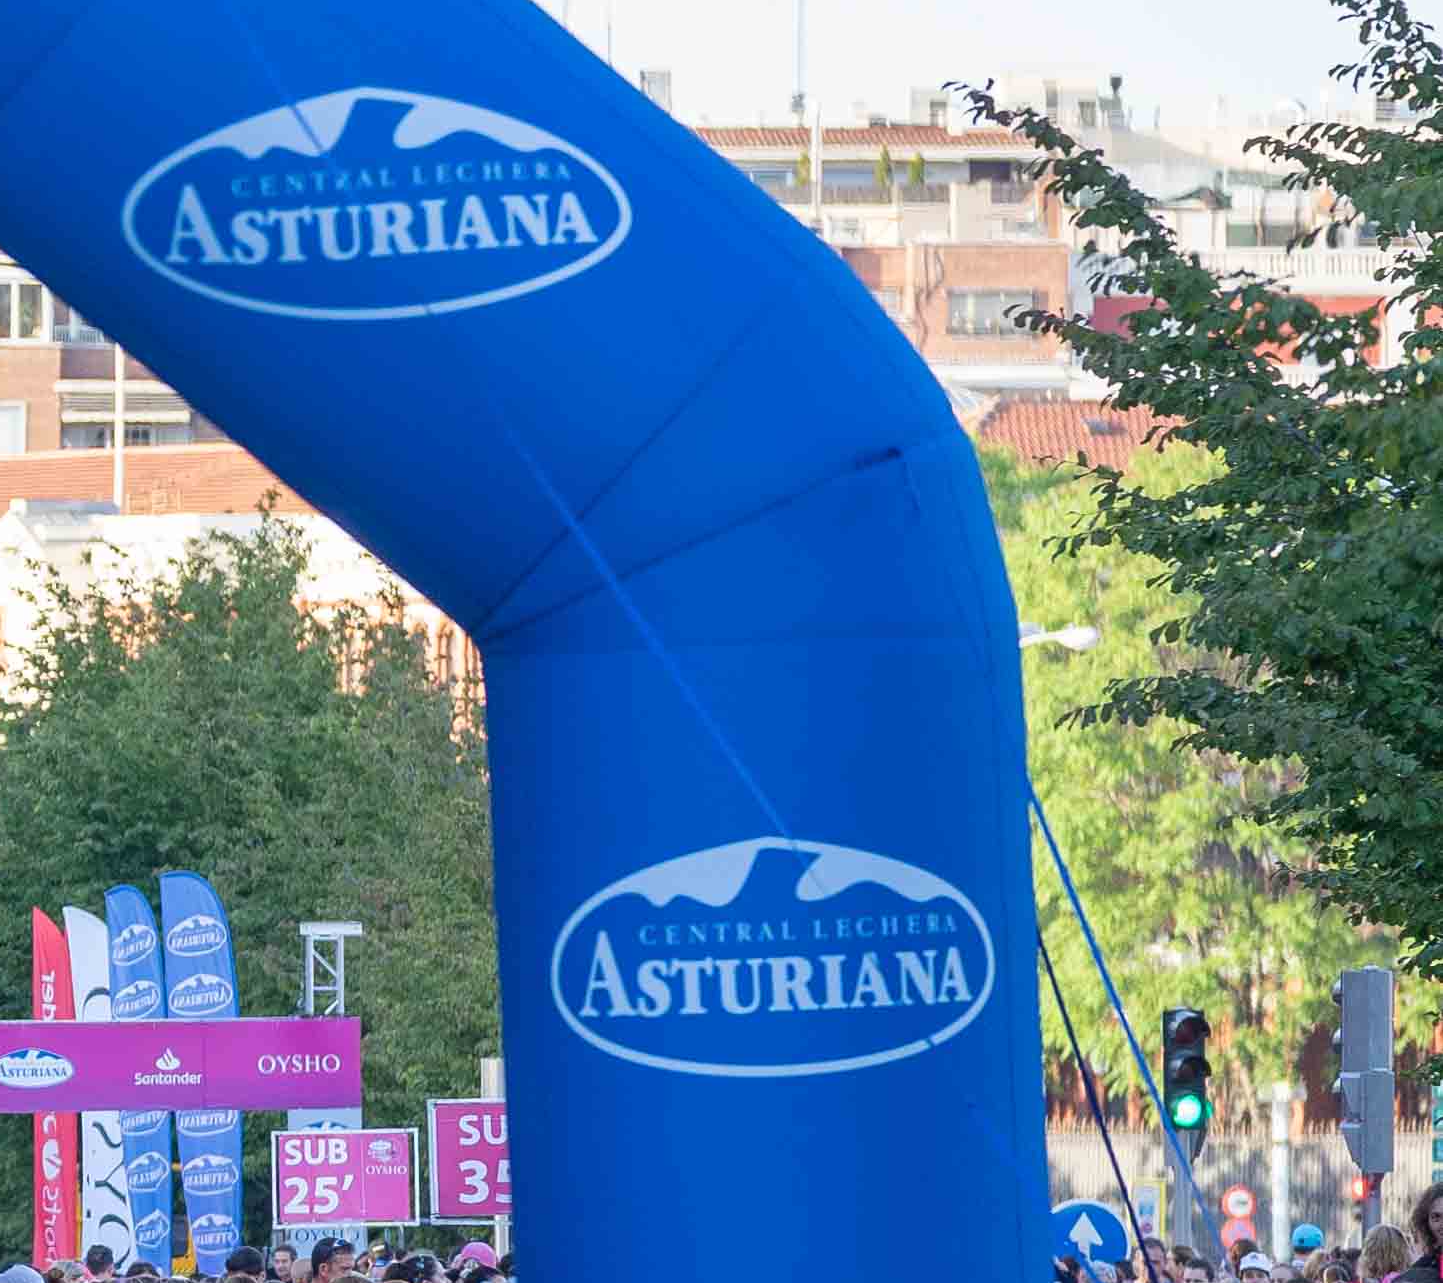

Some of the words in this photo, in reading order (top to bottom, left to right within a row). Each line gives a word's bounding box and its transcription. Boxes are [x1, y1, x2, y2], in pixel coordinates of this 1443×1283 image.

[231, 169, 396, 198] CENTRAL
[412, 161, 572, 187] LECHERA
[165, 183, 599, 266] ASTURIANA
[638, 919, 798, 947] CENTRAL
[812, 911, 961, 941] LECHERA
[578, 930, 973, 1018] ASTURIANA
[133, 1072, 203, 1086] Santander
[257, 1053, 341, 1075] OYSHO
[458, 1114, 509, 1147] SU
[284, 1138, 349, 1166] SUB
